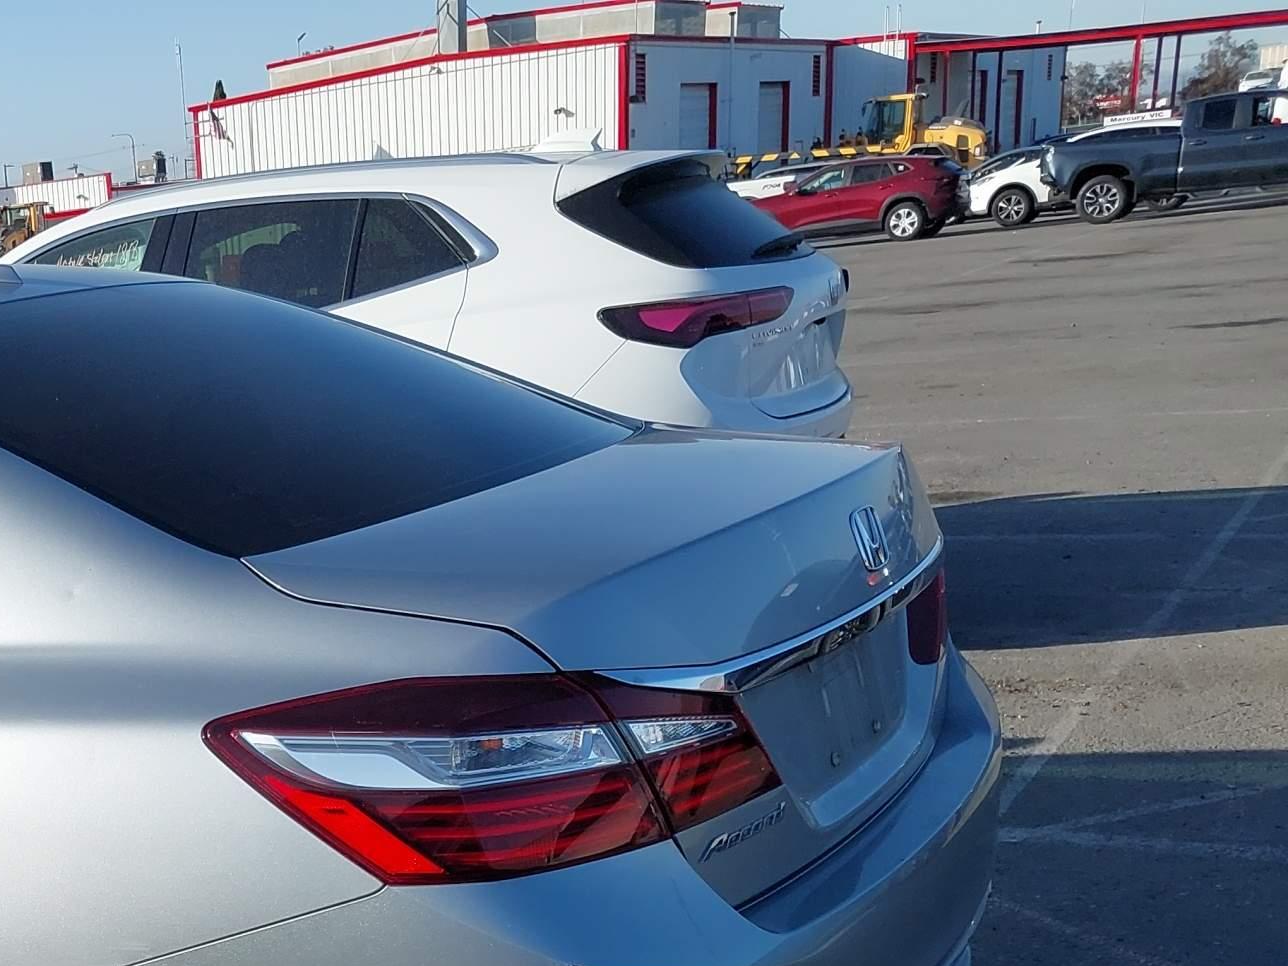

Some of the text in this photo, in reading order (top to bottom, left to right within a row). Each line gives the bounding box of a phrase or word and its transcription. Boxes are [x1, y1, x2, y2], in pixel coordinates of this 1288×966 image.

[1110, 111, 1164, 123] Mercury VIC
[698, 801, 786, 863] Accord
